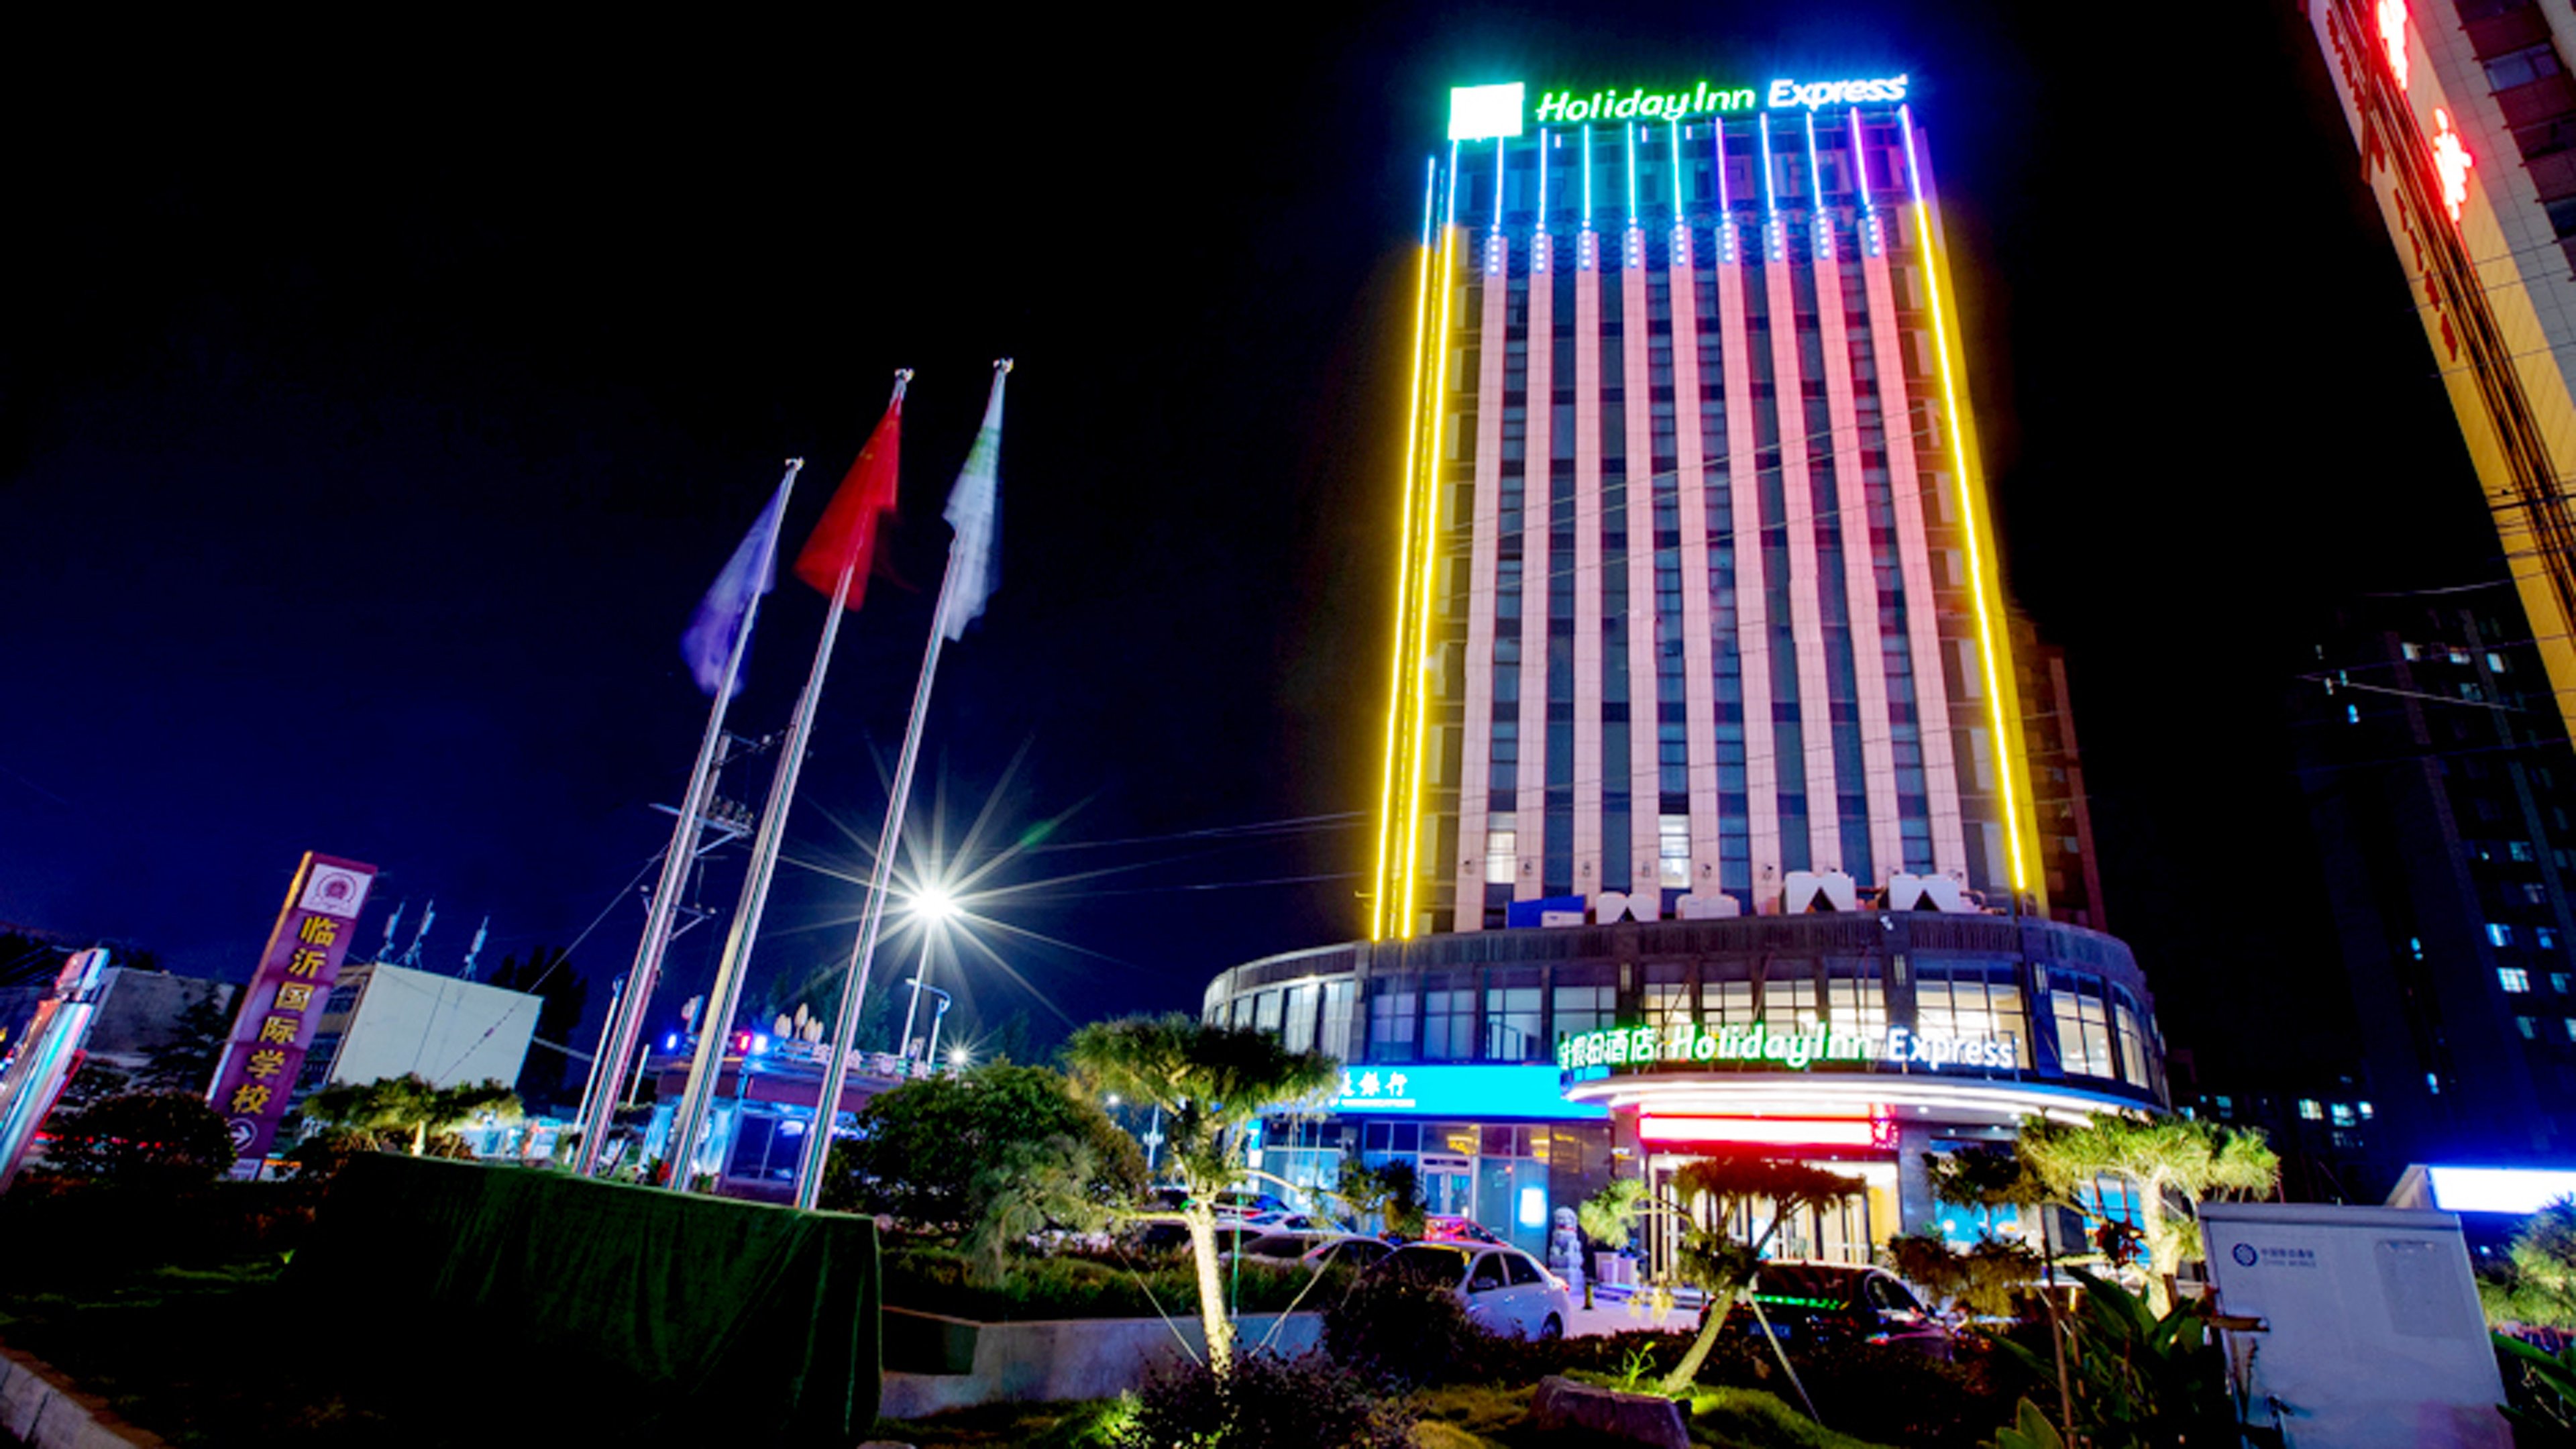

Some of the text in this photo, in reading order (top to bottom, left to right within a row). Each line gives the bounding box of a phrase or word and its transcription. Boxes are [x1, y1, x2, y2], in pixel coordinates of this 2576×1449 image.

[1536, 75, 1907, 121] Holiday Inn Express
[232, 916, 338, 1114] 临沂国际学校
[1668, 1021, 2014, 1070] Holiday Inn Express
